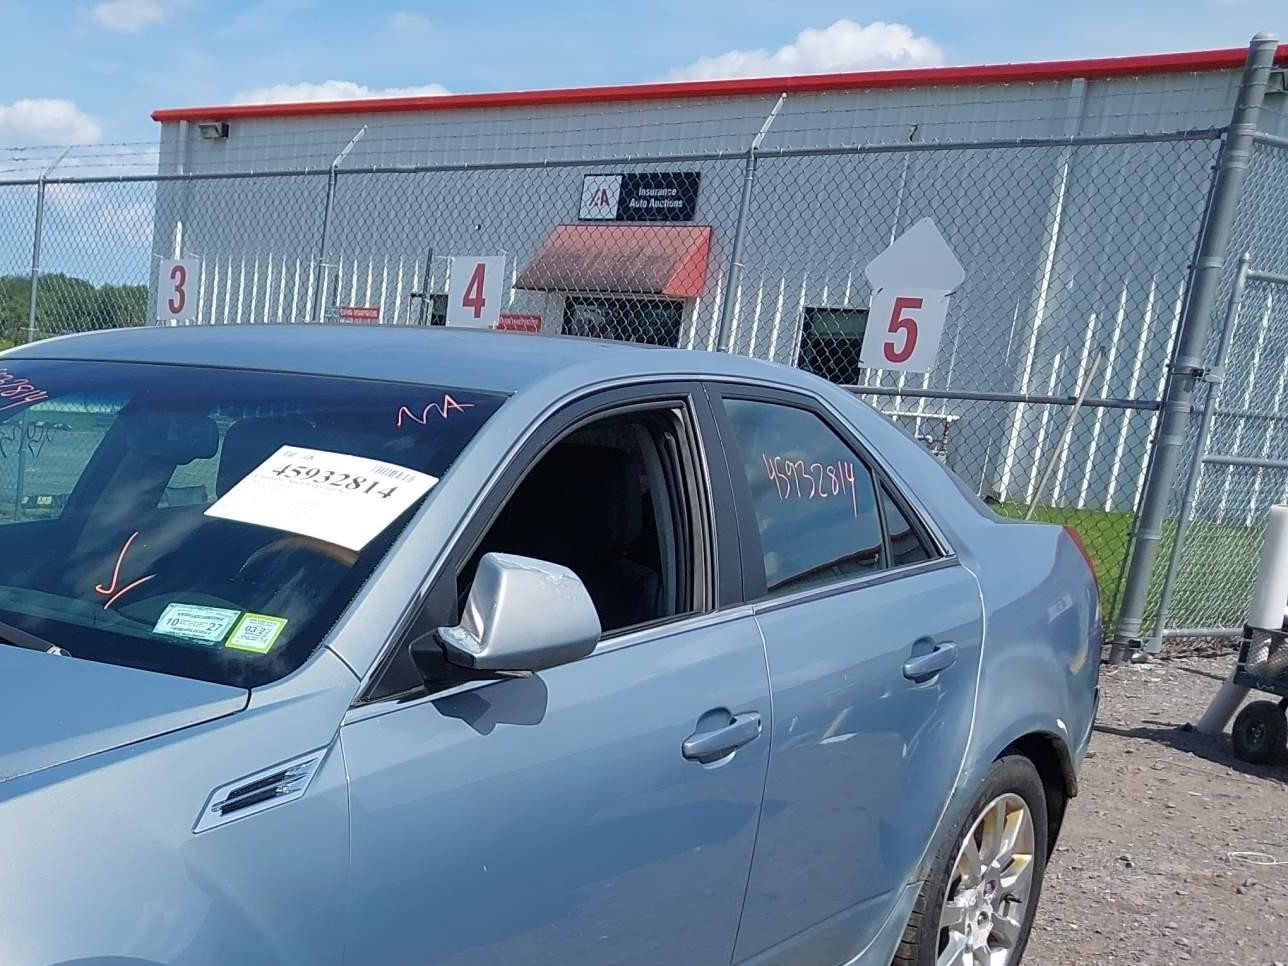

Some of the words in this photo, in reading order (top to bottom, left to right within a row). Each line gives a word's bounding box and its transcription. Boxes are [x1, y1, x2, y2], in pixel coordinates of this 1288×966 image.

[629, 198, 648, 208] Auto
[649, 198, 684, 208] Auctions
[638, 187, 677, 197] Insurance
[168, 265, 186, 314] 3
[462, 263, 487, 319] 4
[883, 297, 924, 363] 5
[272, 464, 399, 499] 45932814
[762, 453, 858, 518] 45932814
[205, 622, 223, 632] 27
